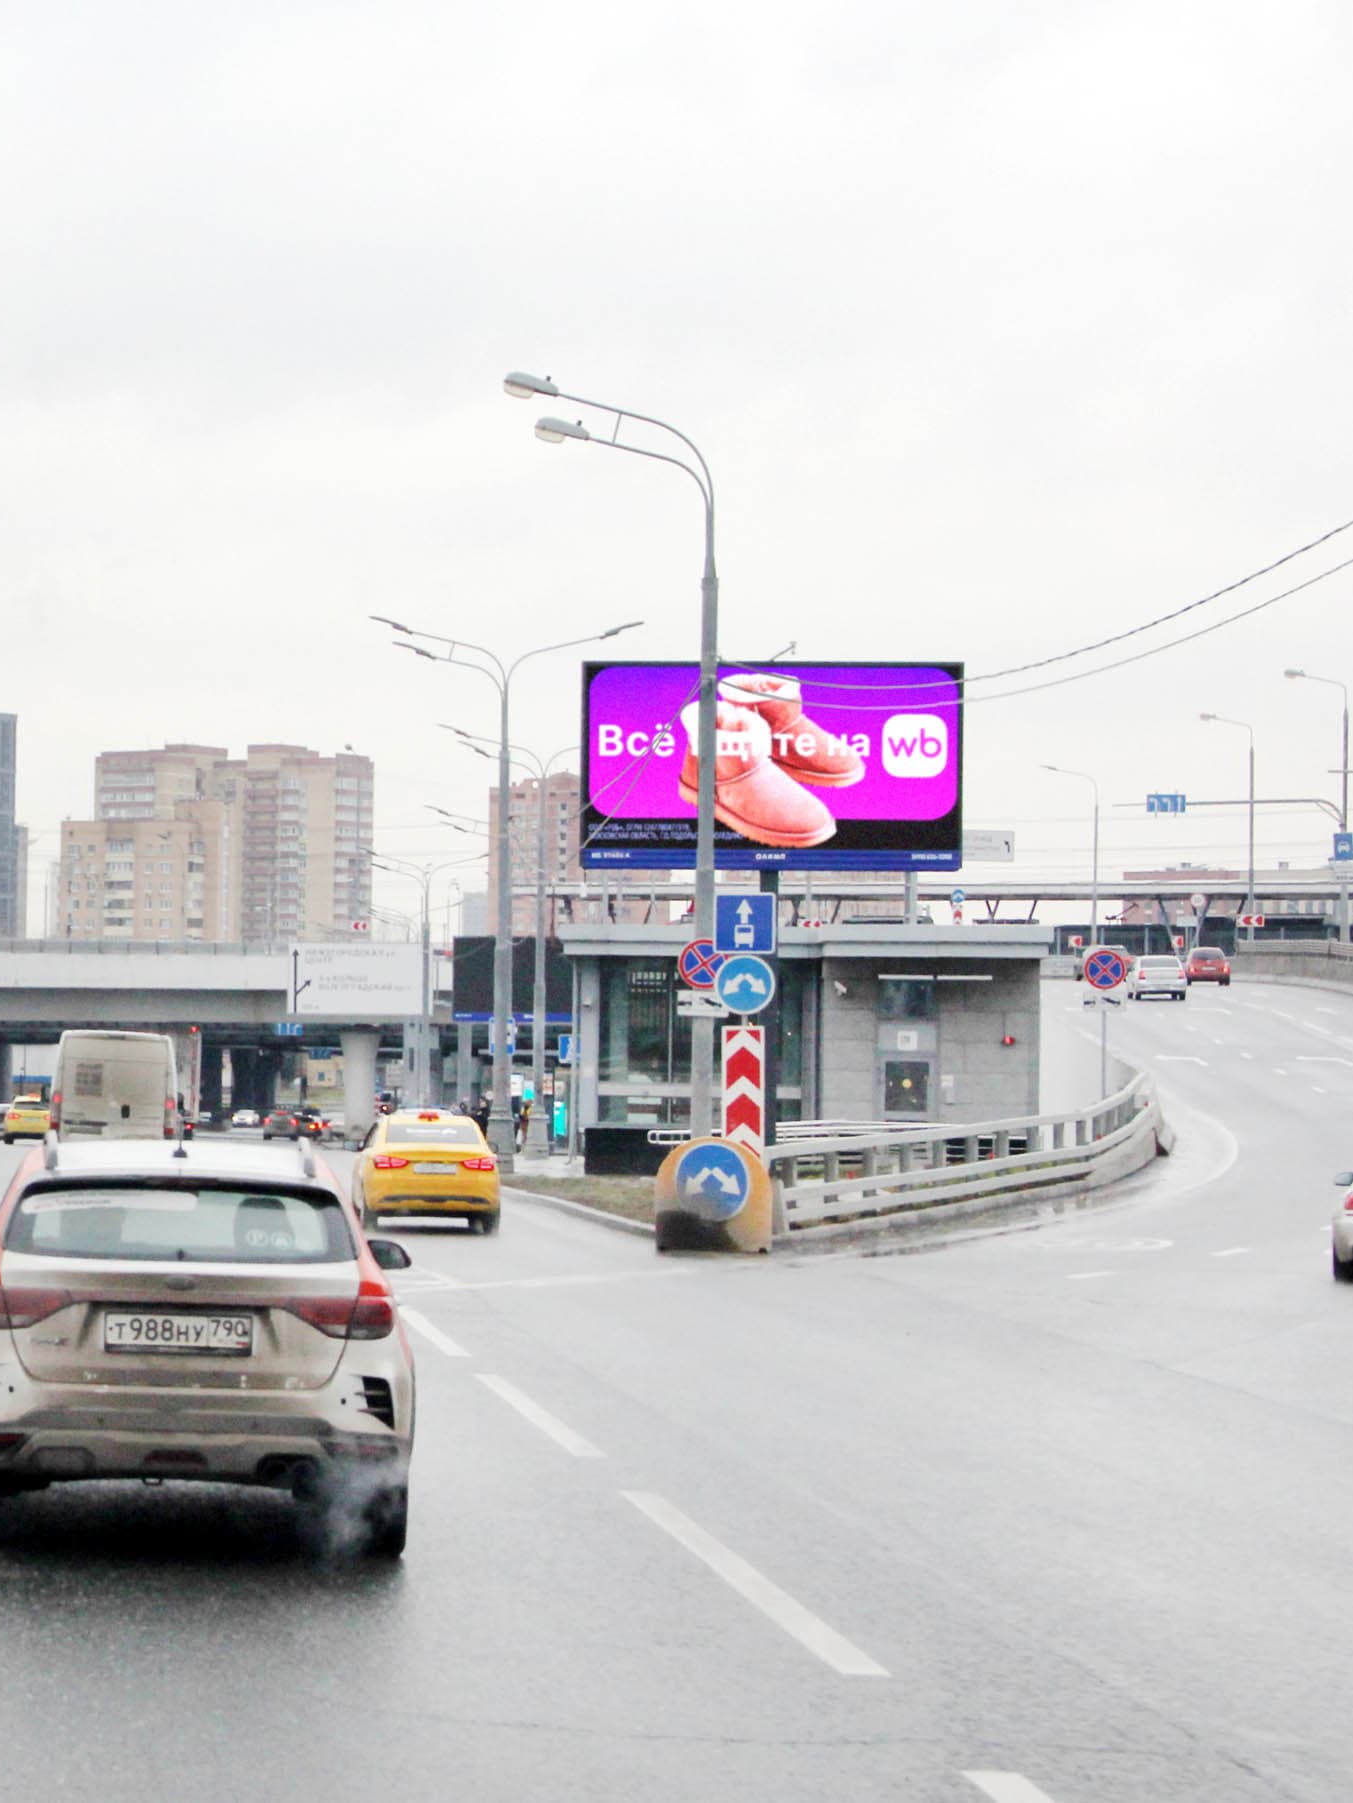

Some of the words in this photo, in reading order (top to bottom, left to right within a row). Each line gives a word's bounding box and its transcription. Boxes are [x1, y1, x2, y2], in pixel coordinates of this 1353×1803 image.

[598, 723, 676, 758] Всё
[691, 732, 817, 761] щте
[828, 733, 870, 757] на
[888, 728, 942, 758] wb
[211, 1320, 246, 1337] 790
